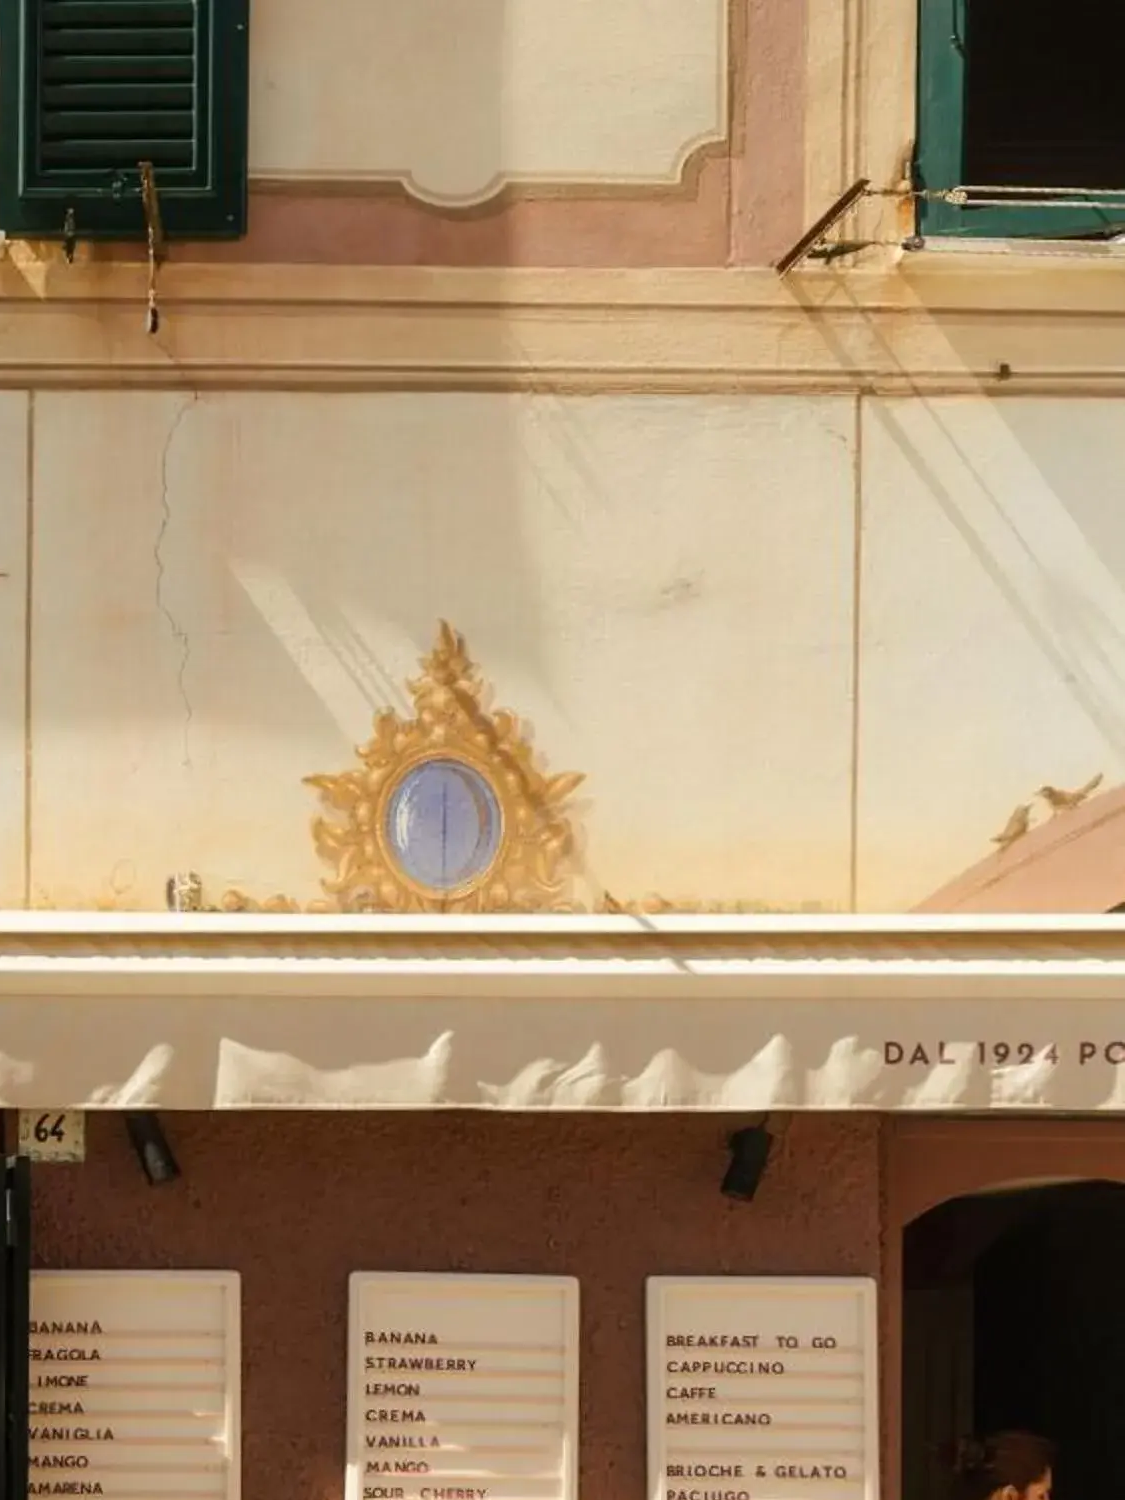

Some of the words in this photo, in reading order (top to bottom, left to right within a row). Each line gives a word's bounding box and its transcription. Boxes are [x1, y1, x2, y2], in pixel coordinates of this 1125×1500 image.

[884, 1041, 957, 1066] DAL
[978, 1041, 1059, 1066] 1924
[34, 1113, 66, 1142] 64
[365, 1331, 438, 1346] BANANA
[666, 1335, 759, 1349] BREAKFAST
[775, 1336, 798, 1350] TO
[812, 1337, 837, 1350] GO
[365, 1356, 477, 1371] STRAWBERRY
[667, 1360, 785, 1376] CAPPUCCINO
[366, 1383, 420, 1397] LEMON
[666, 1387, 717, 1400] CAFFE
[366, 1409, 426, 1423] CREMA
[666, 1413, 772, 1426] AMERICANO
[366, 1435, 440, 1449] VANILLA
[366, 1461, 429, 1475] MANGO
[666, 1465, 743, 1478] BRIOCHE
[755, 1465, 766, 1478] &
[775, 1465, 847, 1479] GELATO
[363, 1487, 404, 1500] SOUR
[420, 1487, 487, 1500] CHERRY
